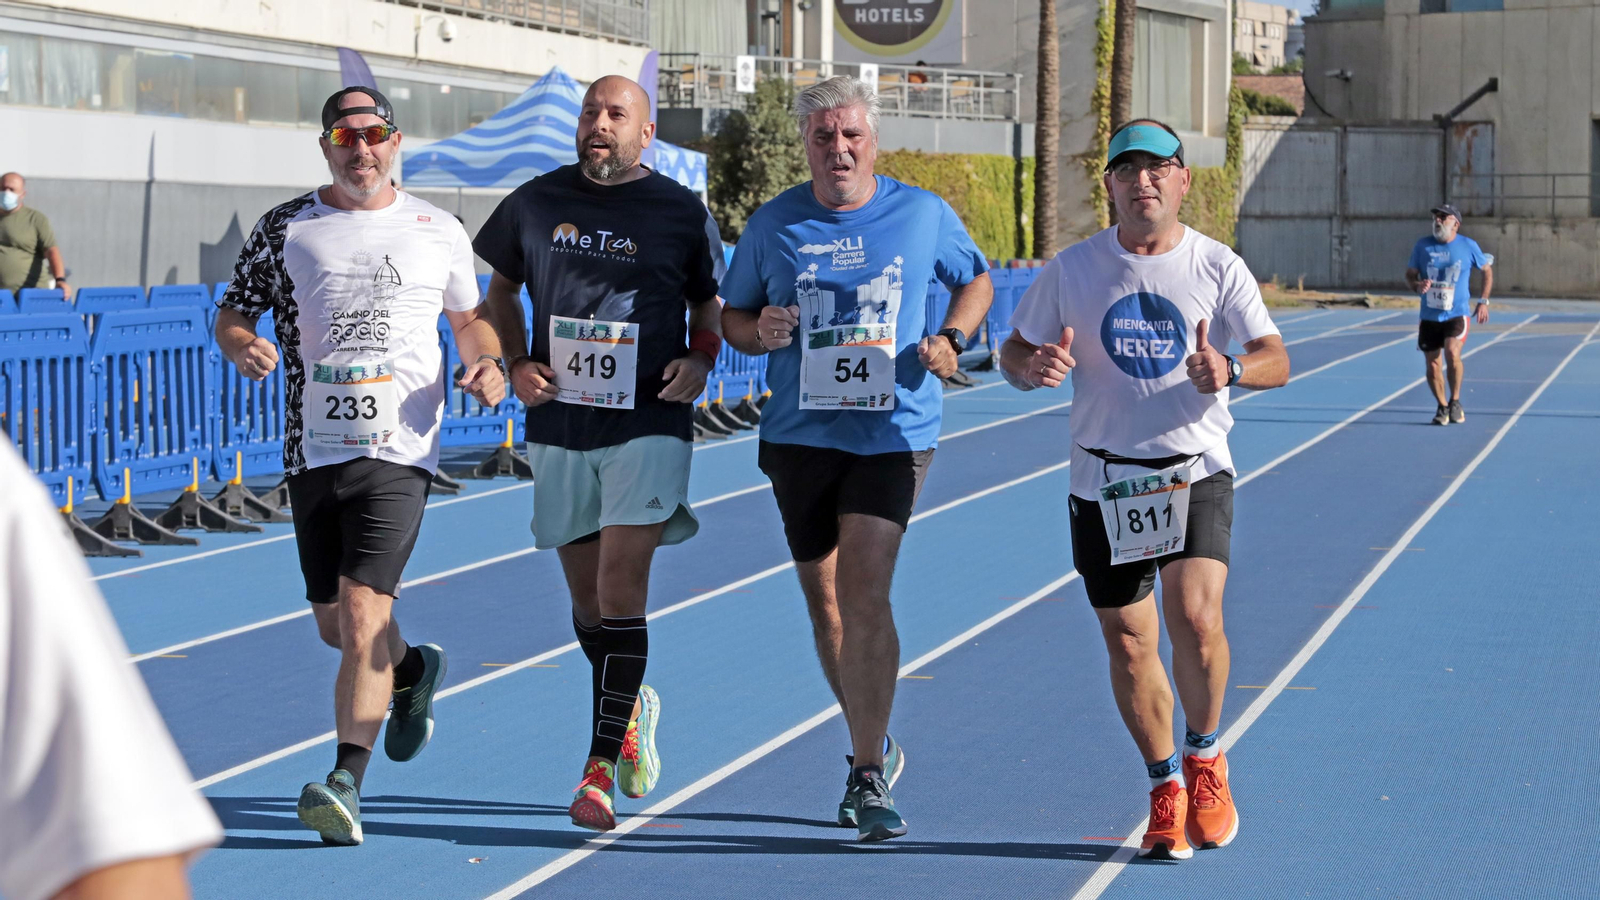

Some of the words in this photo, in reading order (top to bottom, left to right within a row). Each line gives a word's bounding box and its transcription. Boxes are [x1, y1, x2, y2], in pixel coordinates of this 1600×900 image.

[855, 8, 925, 23] HOTELS
[832, 236, 863, 251] XLI
[550, 246, 583, 255] Deporte
[587, 250, 606, 258] Para
[611, 254, 636, 263] Todos
[832, 250, 864, 259] Carrera
[832, 257, 865, 266] Popular
[332, 310, 370, 319] CAMINO
[372, 309, 391, 318] DEL
[1113, 318, 1174, 331] MENCANTA
[1114, 337, 1176, 359] JEREZ
[567, 352, 617, 379] 419
[835, 357, 869, 382] 54
[325, 395, 378, 421] 233
[1127, 503, 1172, 533] 811
